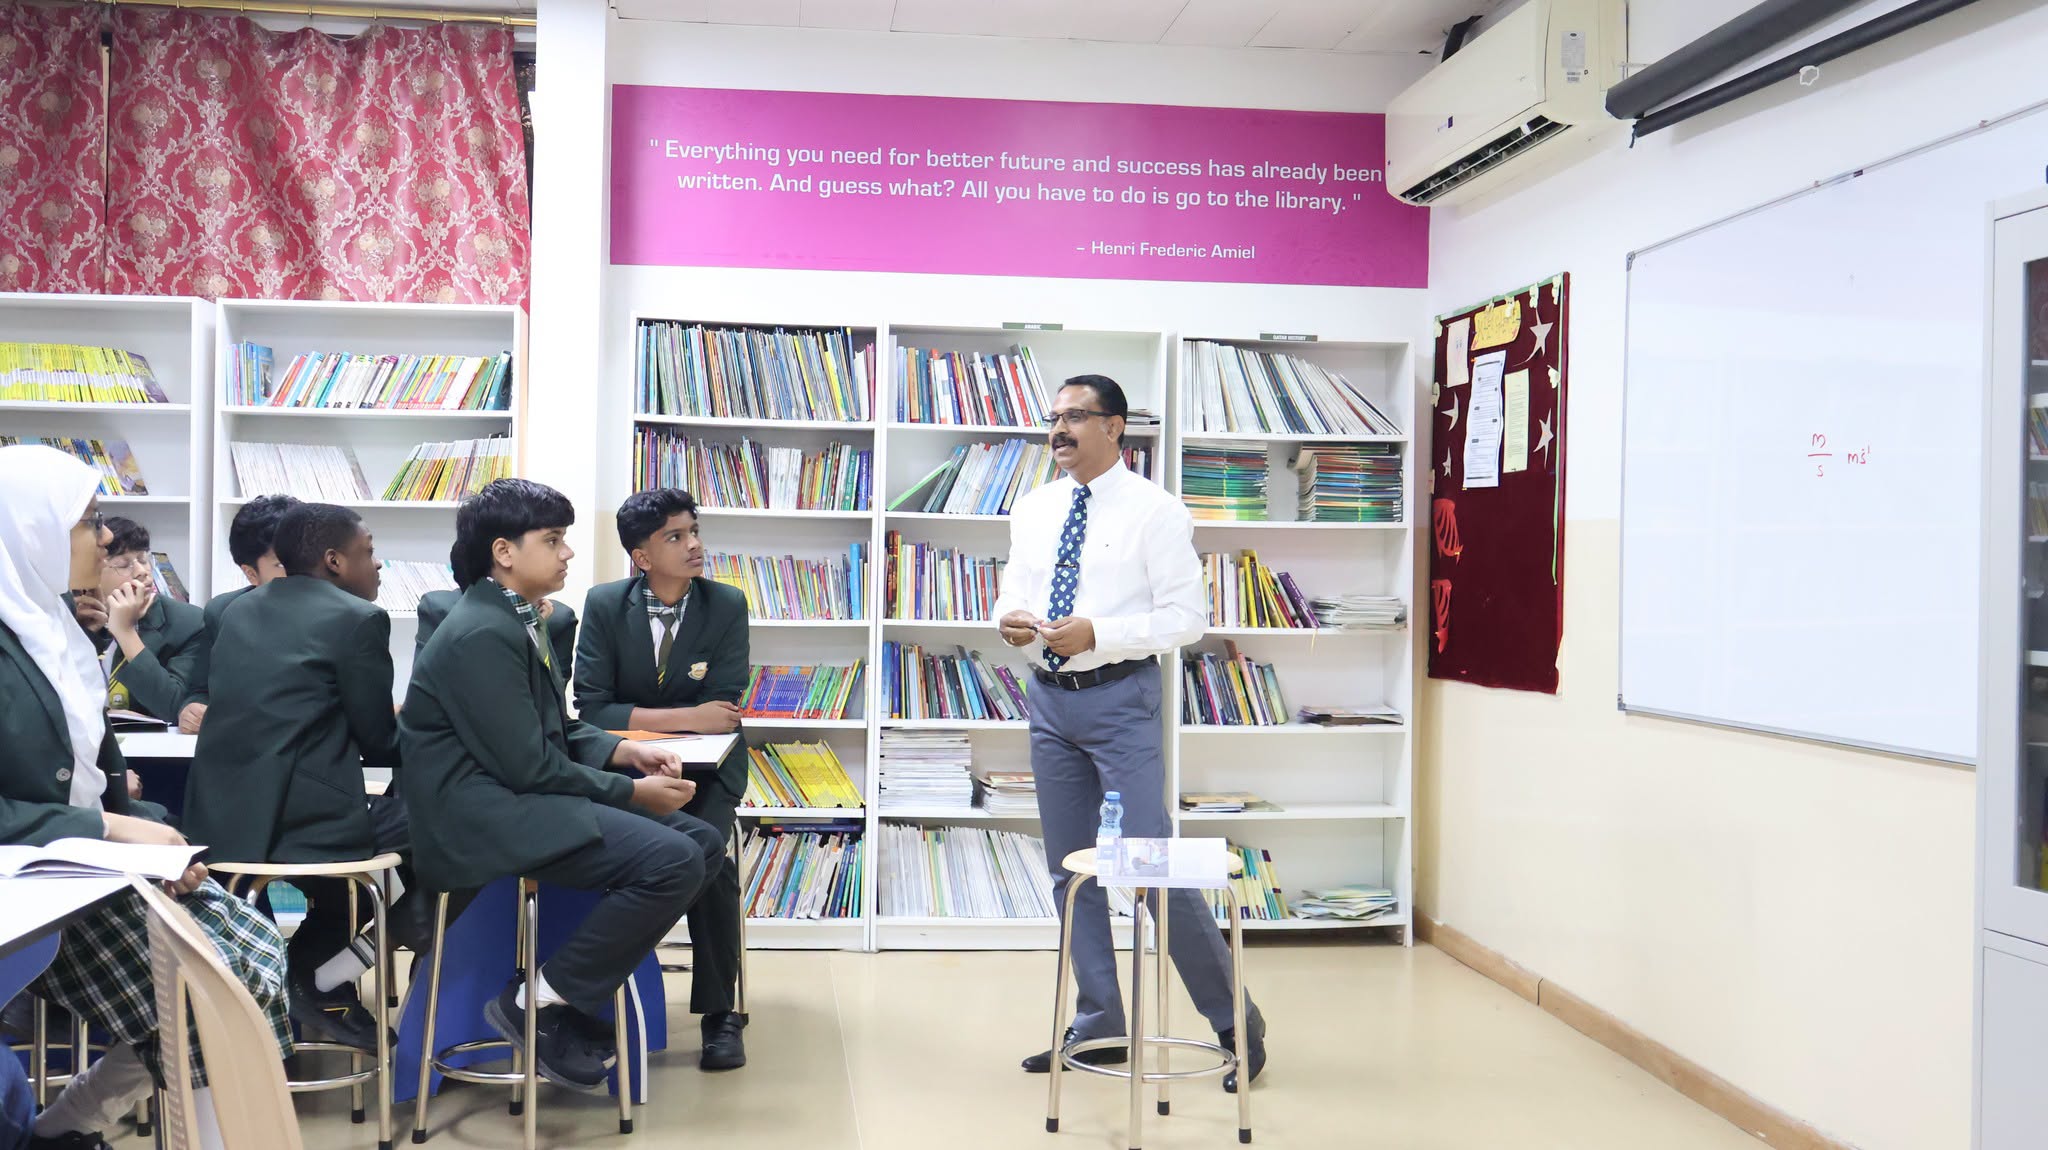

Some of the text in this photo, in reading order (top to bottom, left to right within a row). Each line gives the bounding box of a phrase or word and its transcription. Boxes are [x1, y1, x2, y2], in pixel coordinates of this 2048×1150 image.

[665, 139, 781, 167] Everything
[786, 148, 824, 167] you
[831, 146, 882, 165] need
[888, 147, 921, 167] for
[926, 148, 995, 169] better
[999, 151, 1066, 172] future
[1072, 155, 1111, 173] and
[1116, 160, 1202, 176] success
[1208, 158, 1246, 178] has
[1251, 160, 1328, 185] already
[1333, 163, 1382, 182] been
[677, 171, 763, 191] written.
[768, 173, 812, 193] And
[818, 179, 883, 199] guess
[888, 177, 956, 198] what?
[961, 179, 988, 199] All
[994, 185, 1031, 204] you
[1037, 182, 1087, 202] have
[1092, 186, 1115, 203] to
[1120, 185, 1146, 204] do
[1152, 186, 1170, 205] is
[1175, 191, 1201, 211] go
[1206, 190, 1229, 207] to
[1234, 189, 1269, 208] the
[1275, 190, 1346, 216] library.
[1091, 240, 1136, 257] Henri
[1139, 241, 1207, 259] Frederic
[1210, 243, 1256, 260] Amiel
